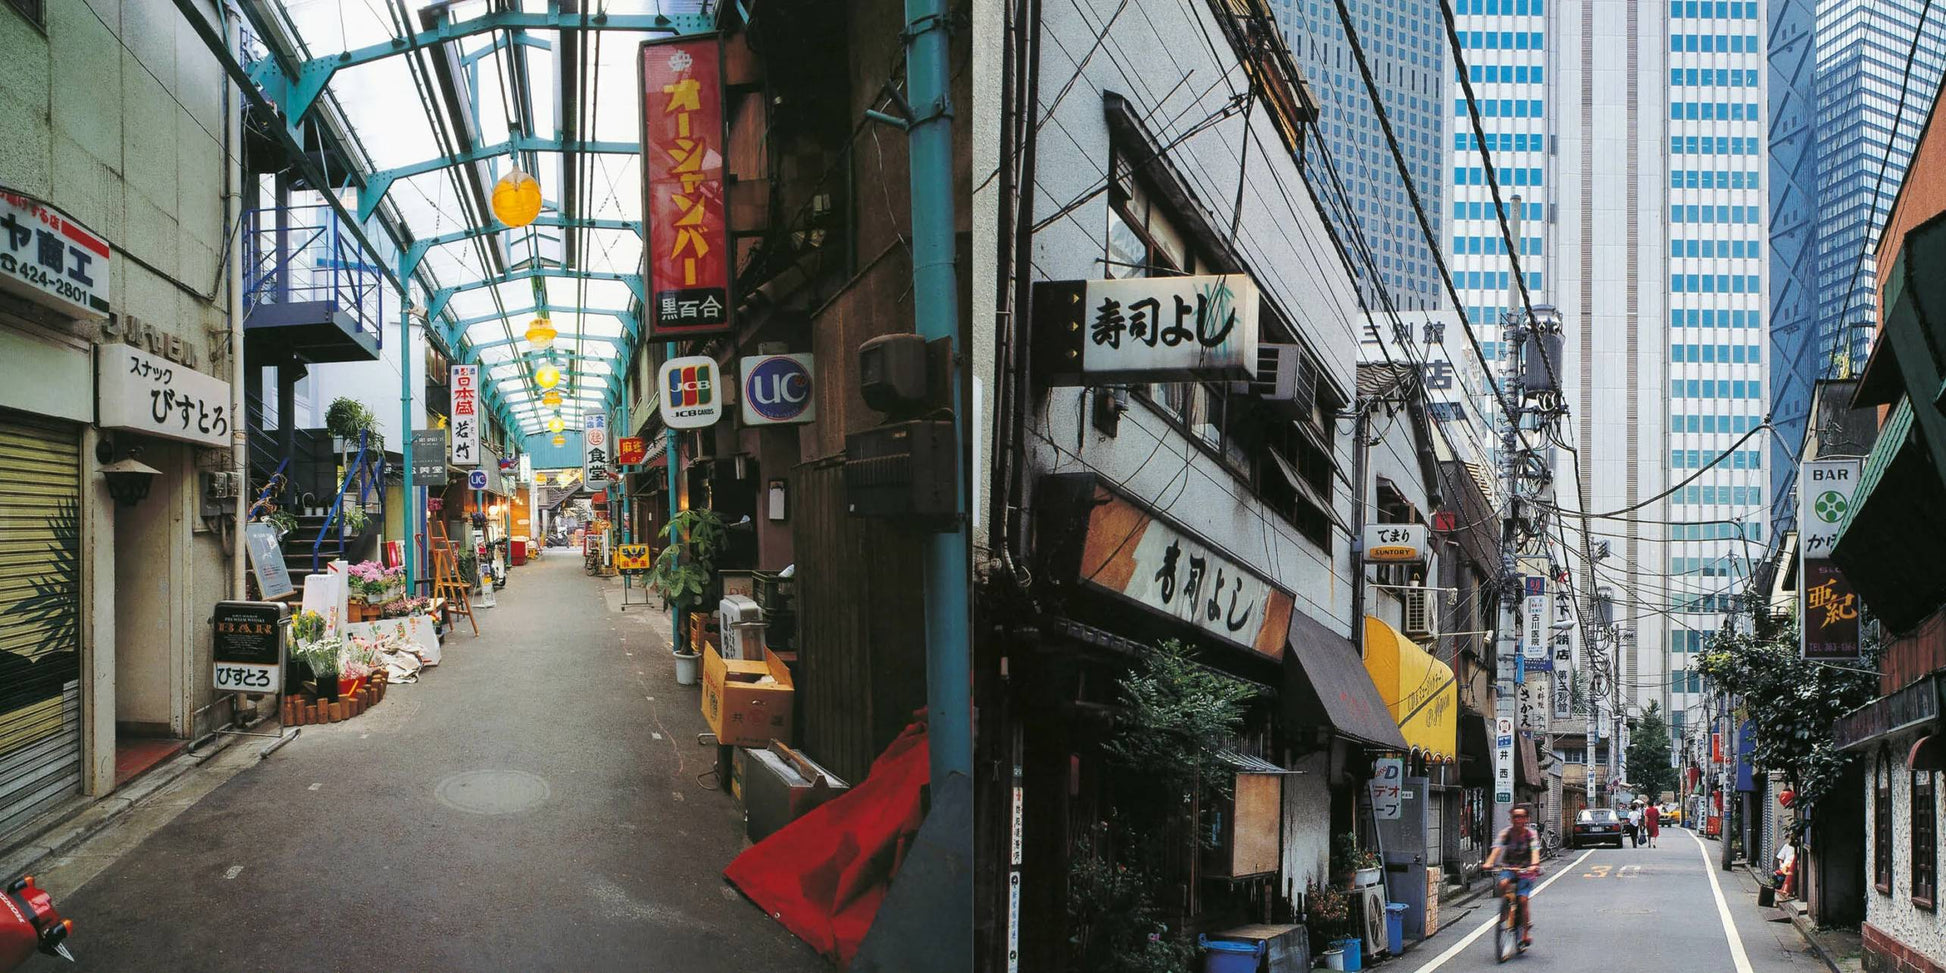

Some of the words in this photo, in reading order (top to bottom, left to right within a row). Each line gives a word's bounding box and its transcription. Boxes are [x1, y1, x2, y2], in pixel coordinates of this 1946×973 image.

[663, 79, 709, 286] オーシャンバー
[20, 262, 87, 305] 424-2801
[661, 297, 723, 321] 黒百合
[1091, 293, 1236, 349] 寿司よし
[130, 356, 173, 385] スナック
[455, 376, 475, 415] 日本盛
[671, 380, 711, 393] JCB
[754, 372, 807, 404] UC
[151, 389, 228, 436] びすとろ
[672, 410, 697, 418] JCB
[456, 421, 471, 460] 若竹
[588, 447, 607, 482] 食堂
[1813, 469, 1849, 481] BAR
[470, 474, 487, 486] UC
[1377, 528, 1410, 543] てまり
[1807, 578, 1858, 631] 亜紀
[216, 668, 271, 687] びすとろ
[1373, 785, 1400, 798] デオ
